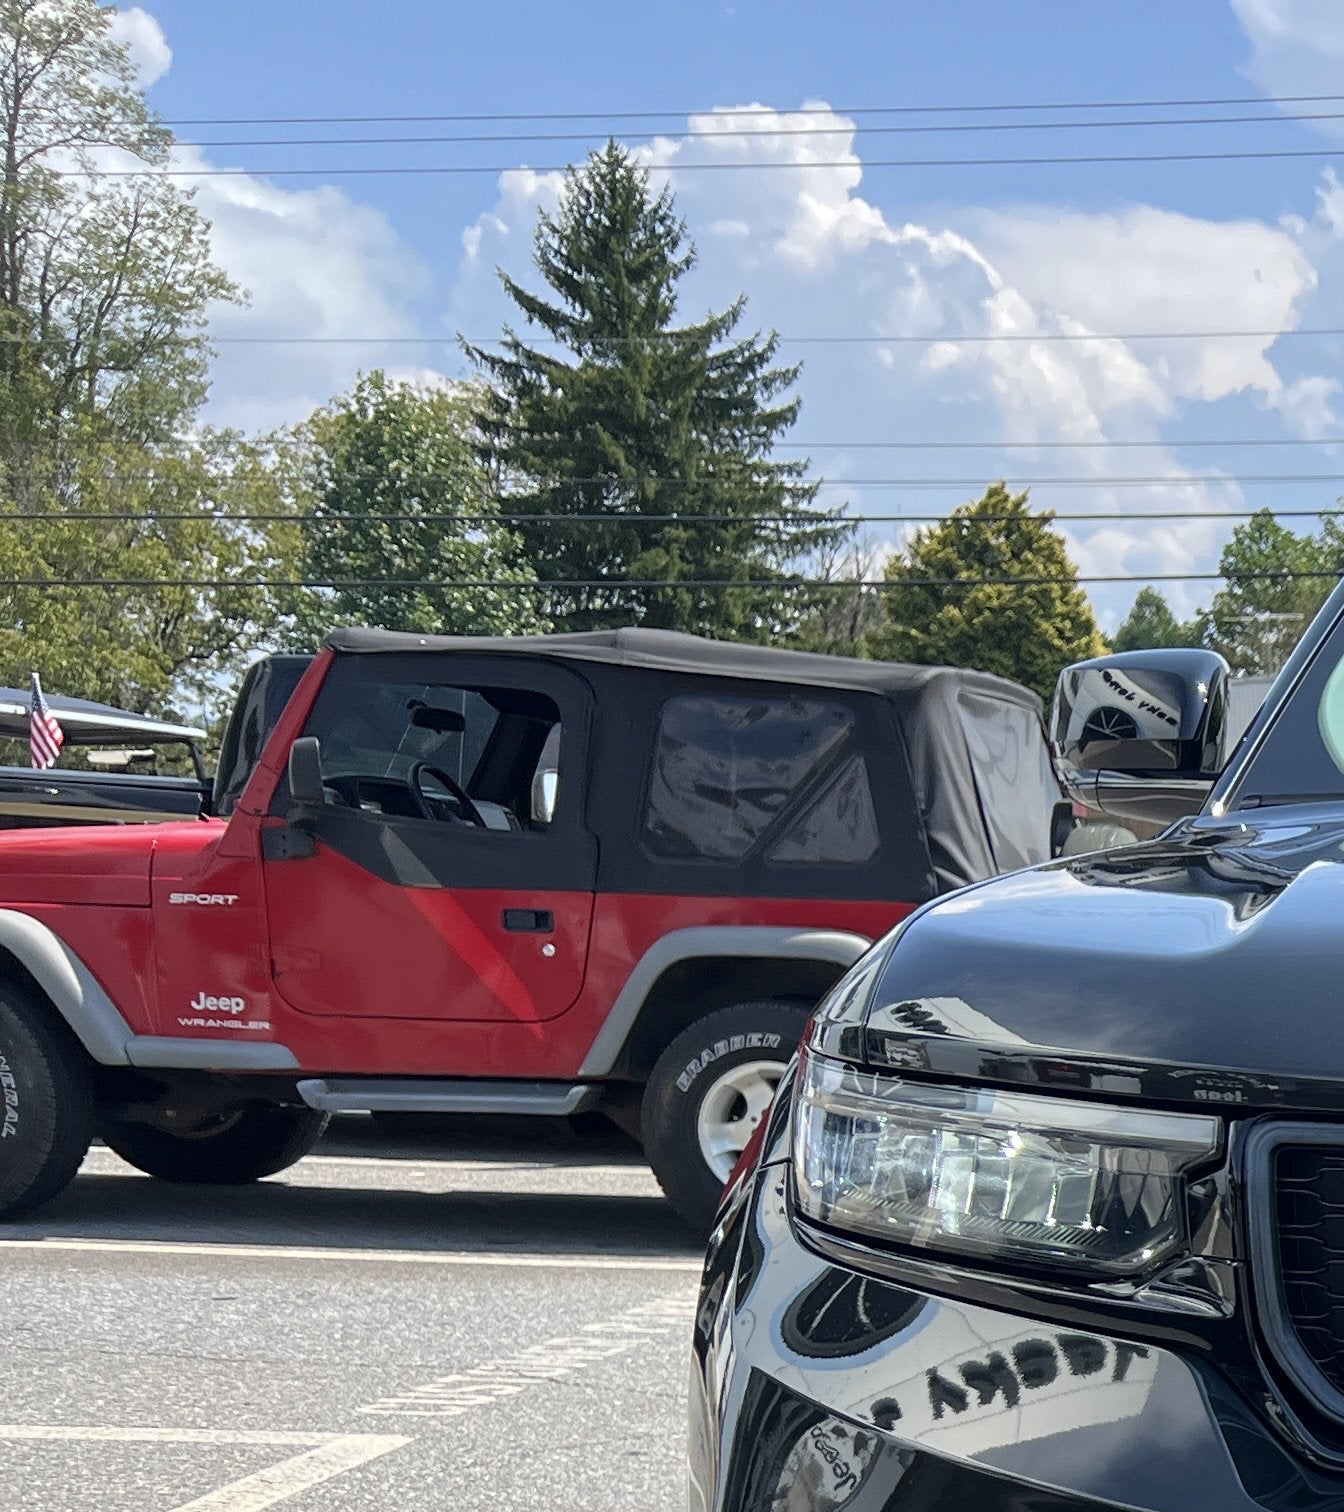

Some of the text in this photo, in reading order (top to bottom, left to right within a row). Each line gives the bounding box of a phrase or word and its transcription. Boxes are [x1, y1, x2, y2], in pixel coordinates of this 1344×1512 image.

[169, 892, 239, 906] SPORT
[190, 991, 245, 1015] Jeep
[177, 1017, 271, 1031] WRANGLER
[677, 1032, 781, 1092] GRABBER
